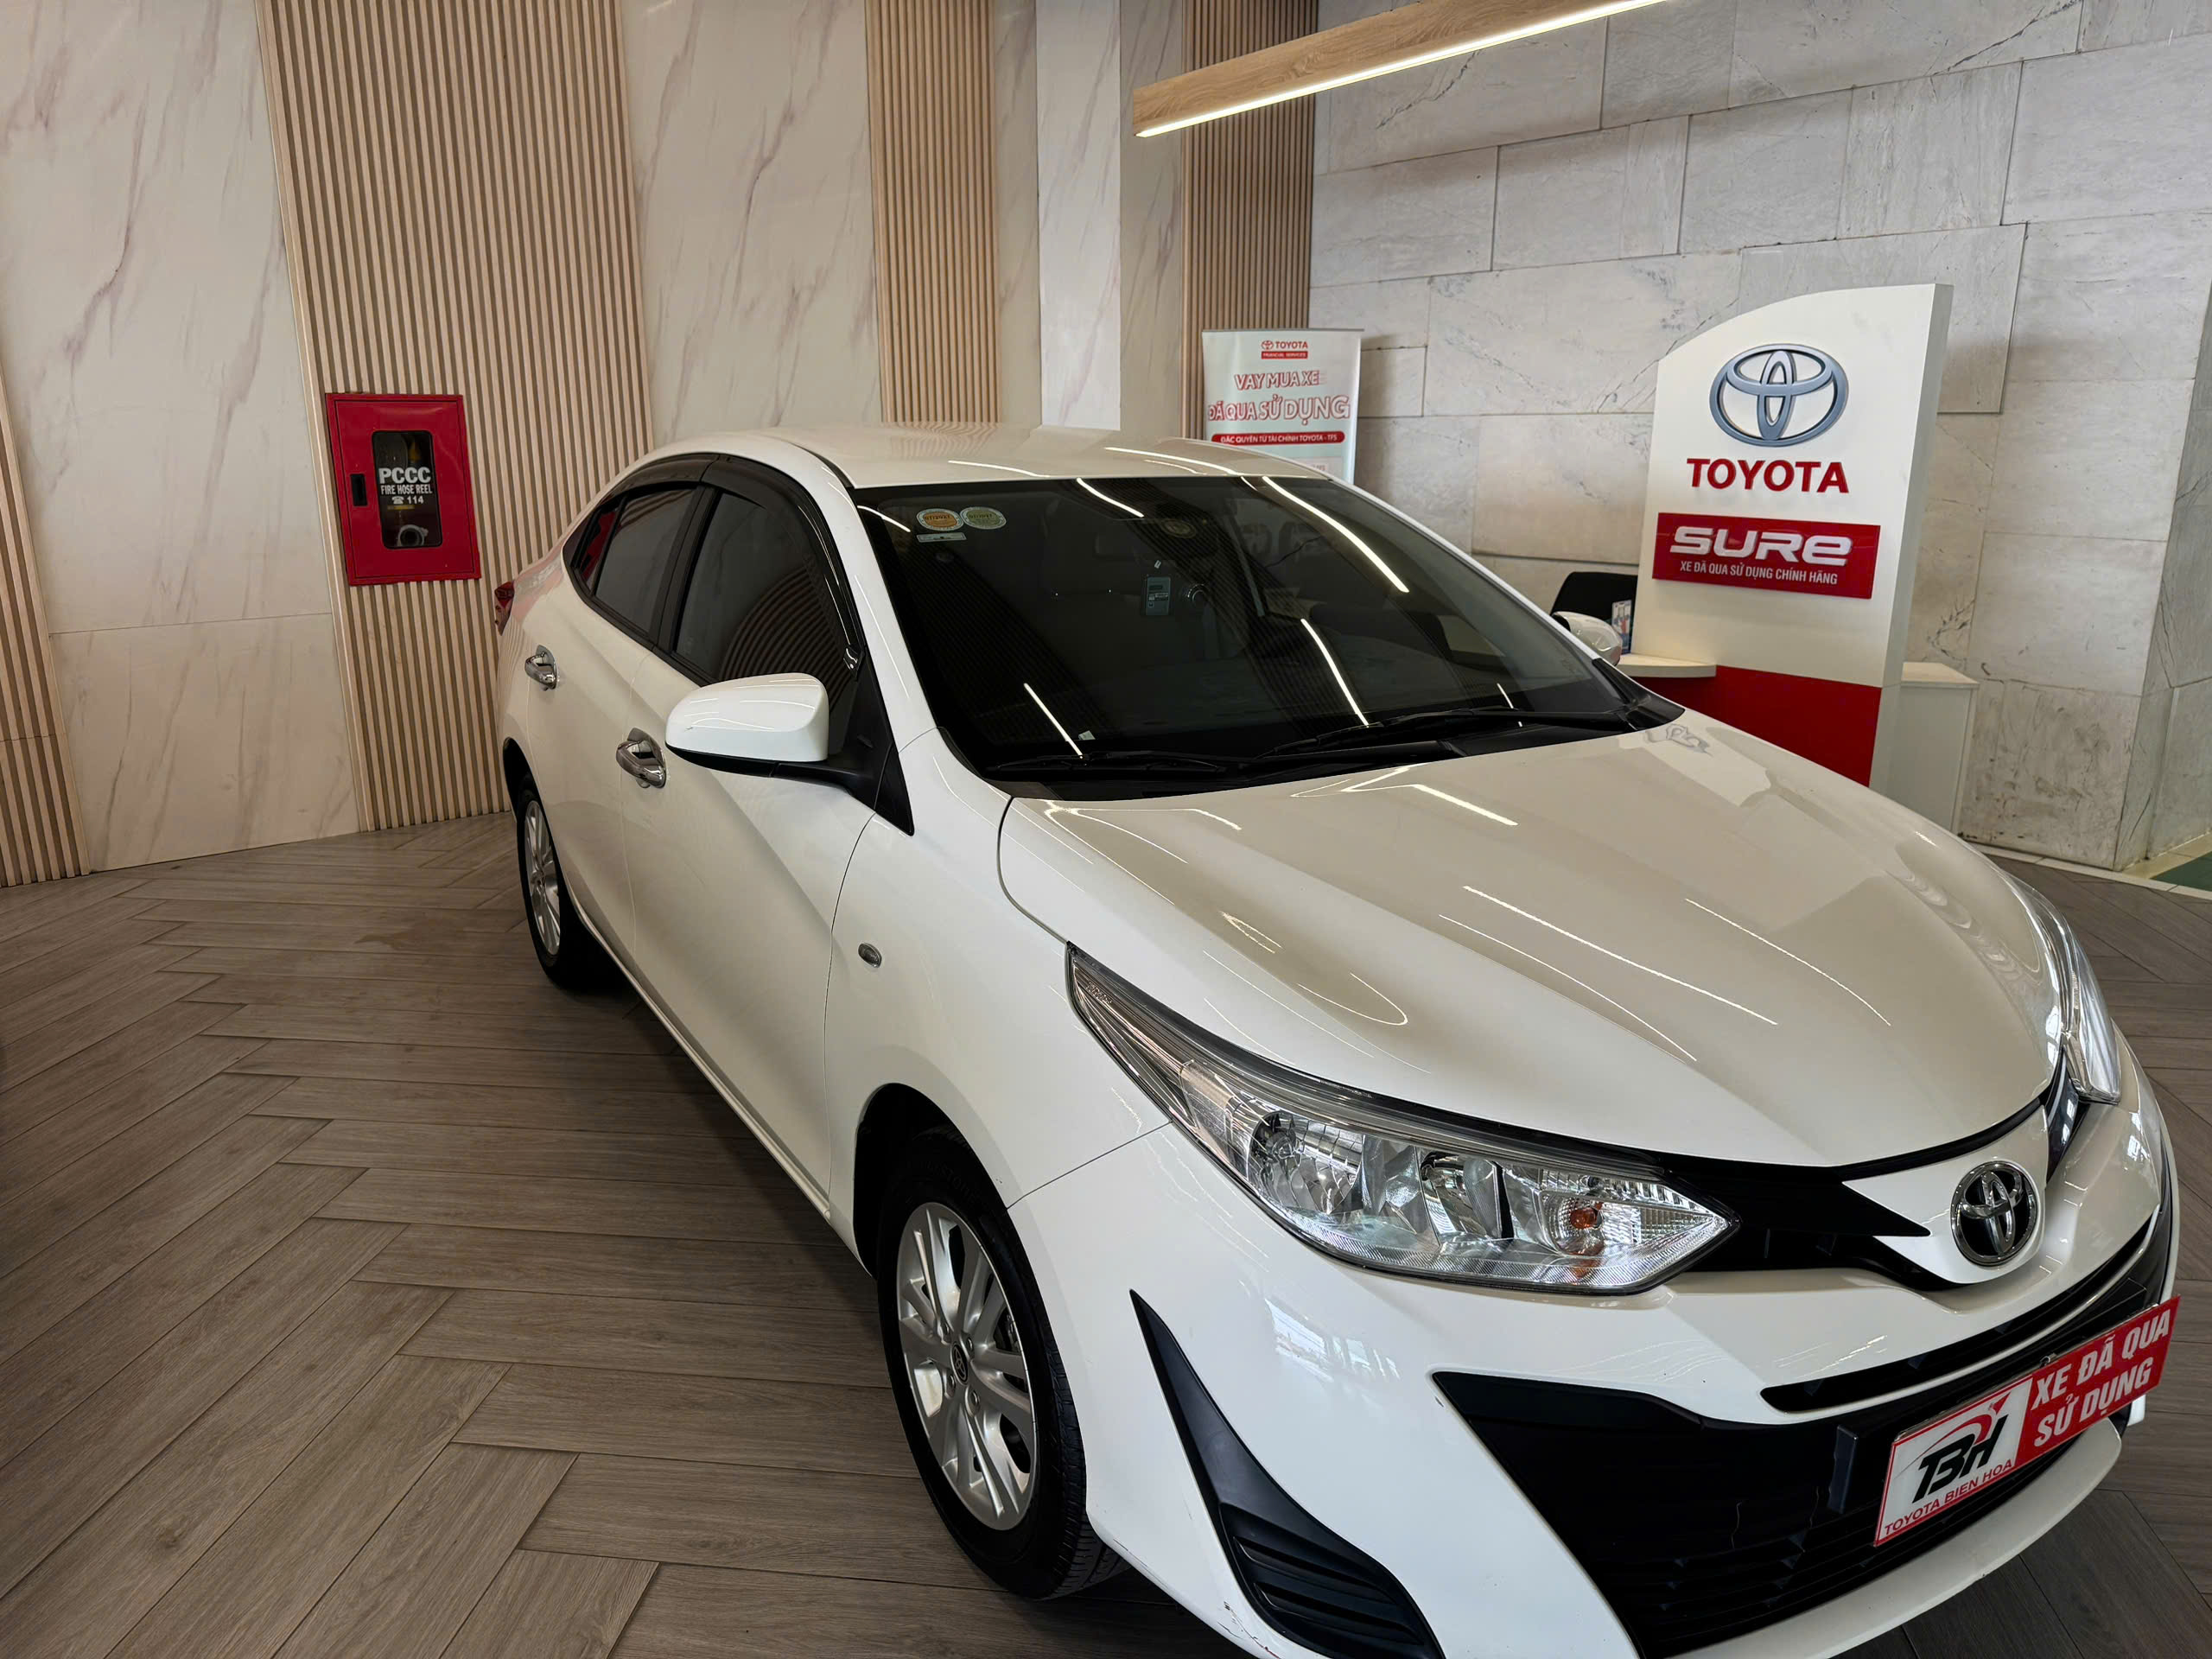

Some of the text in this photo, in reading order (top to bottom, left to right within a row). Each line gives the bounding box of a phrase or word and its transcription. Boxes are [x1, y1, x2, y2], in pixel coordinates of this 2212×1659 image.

[1234, 370, 1320, 390] VAY MUA XE
[1225, 402, 1257, 421] QUA
[1258, 394, 1283, 421] SỬ
[1284, 395, 1351, 426] DỤNG
[1299, 434, 1323, 442] TOYOTA
[378, 467, 431, 484] PCCC
[1687, 458, 1849, 493] TOYOTA
[380, 484, 432, 495] FIRE HOSE REEL
[407, 496, 424, 505] 114
[1680, 561, 1839, 585] XE ĐÃ QUA SỬ DỤNG CHÍNH HÃNG
[2031, 1309, 2171, 1410] XE ĐÃ QUA
[2034, 1357, 2154, 1446] SỬ DỤNG
[1884, 1459, 2012, 1535] TOYOTA BIEN HOA
